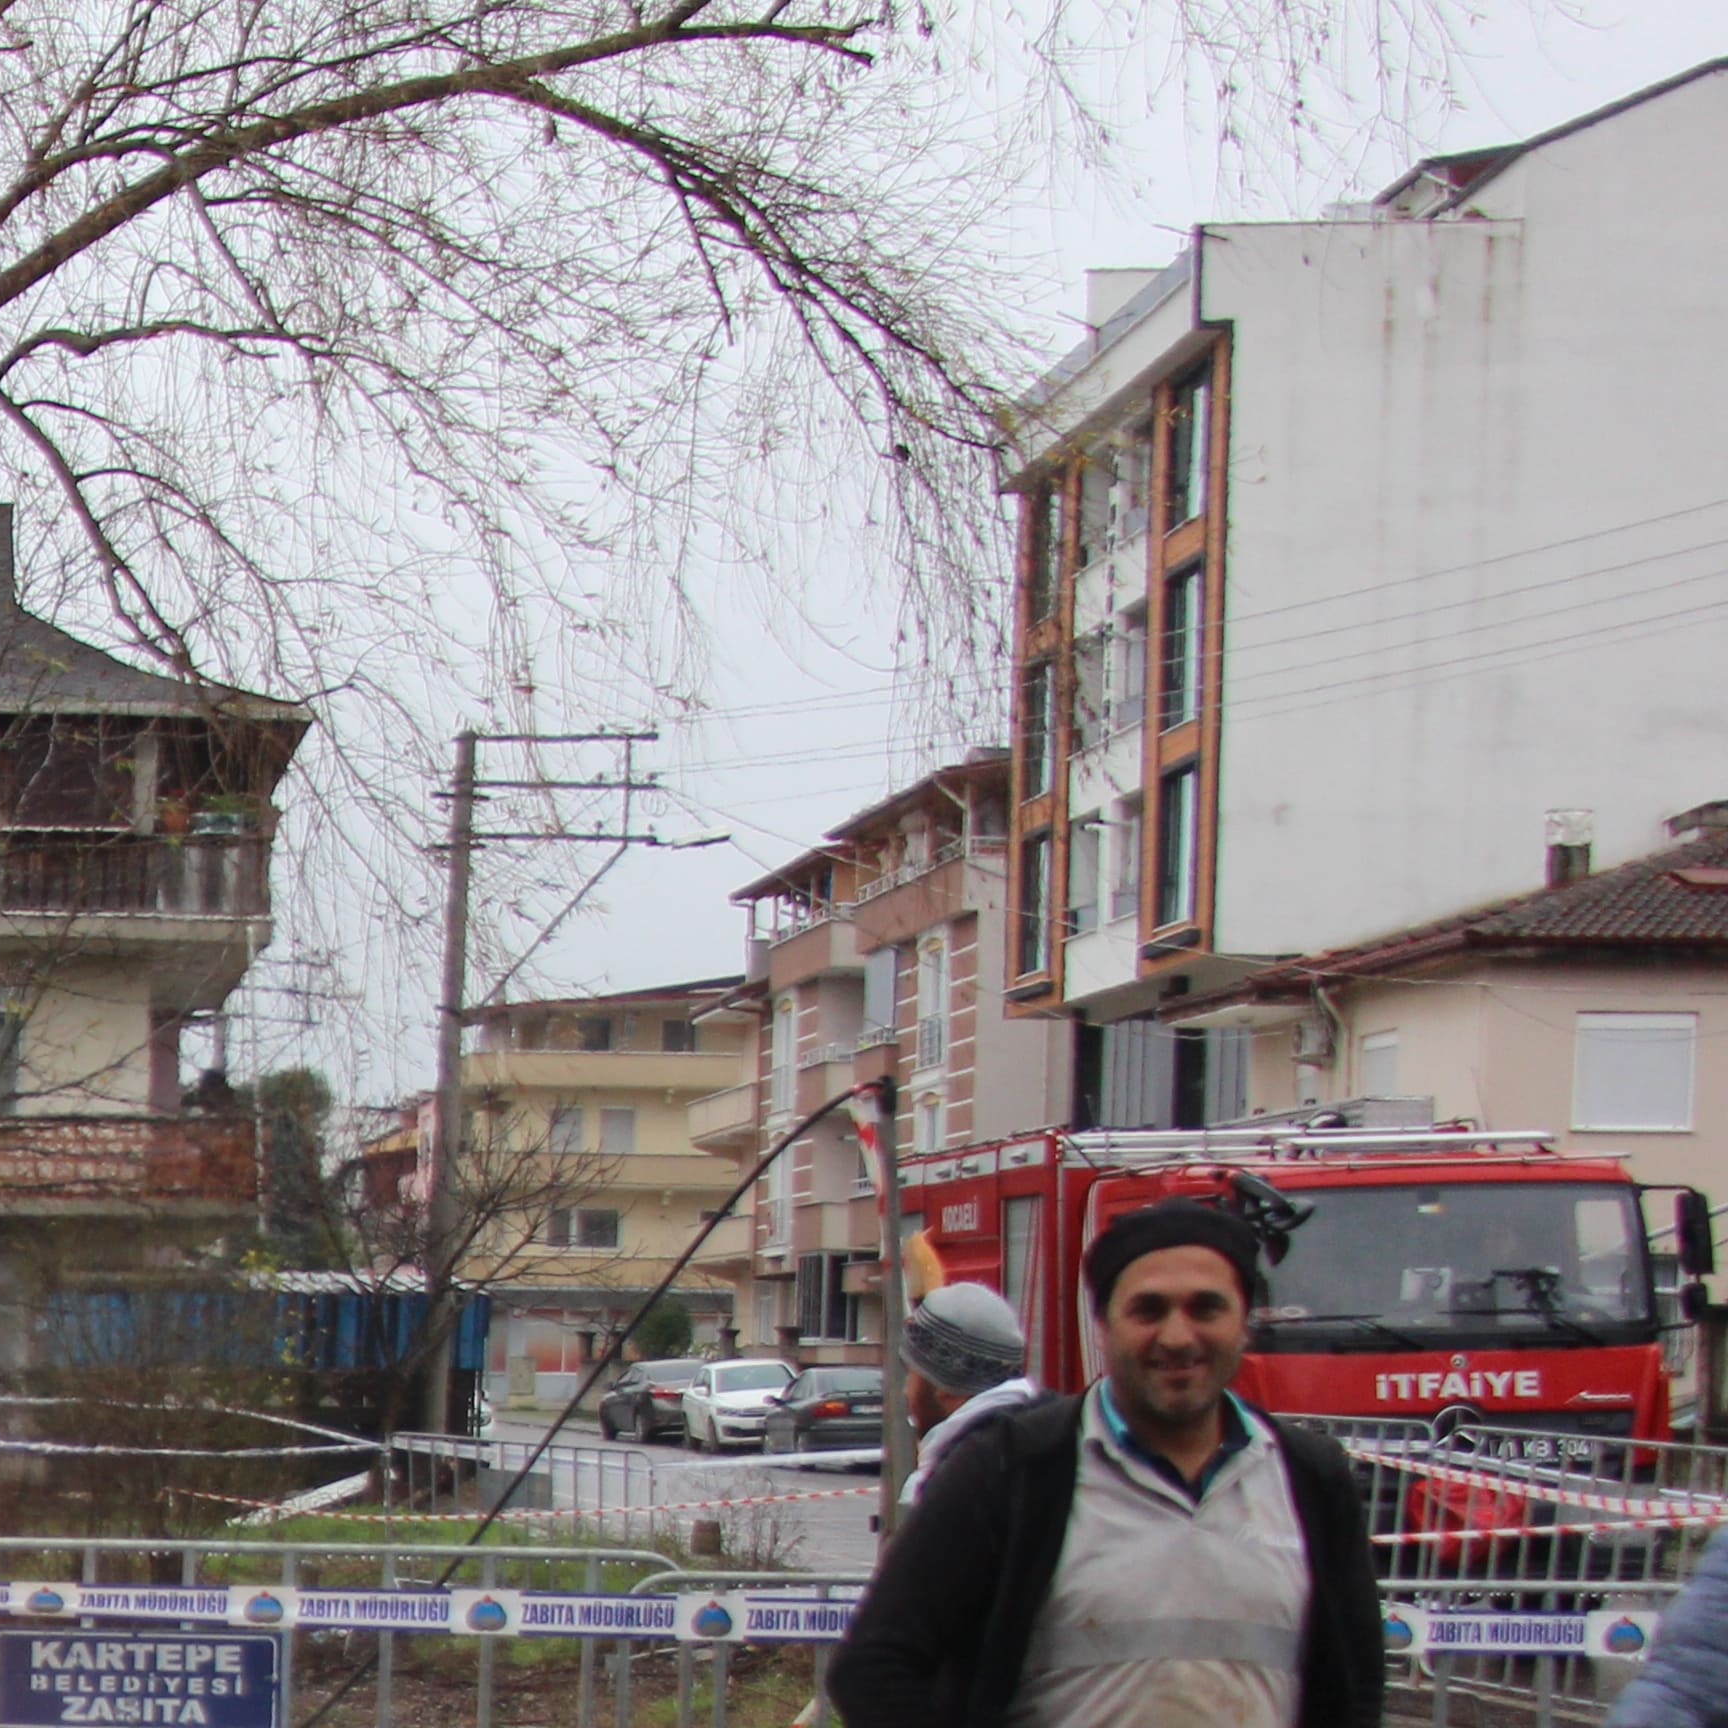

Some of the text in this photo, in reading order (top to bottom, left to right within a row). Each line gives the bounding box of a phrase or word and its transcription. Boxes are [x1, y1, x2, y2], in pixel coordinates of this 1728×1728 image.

[79, 1592, 130, 1609] ZABITA
[298, 1595, 451, 1622] ZABITA MÜDÜRLÜĞÜ
[521, 1600, 675, 1629] ZABITA MÜDÜRLÜĞÜ
[746, 1609, 800, 1631] ZABITA
[1427, 1619, 1585, 1646] ZABITA MÜDÜRLÜĞÜ
[30, 1640, 242, 1673] KARTEPE
[30, 1671, 244, 1696] BELEDİYESİ
[60, 1696, 207, 1725] ZABITA
